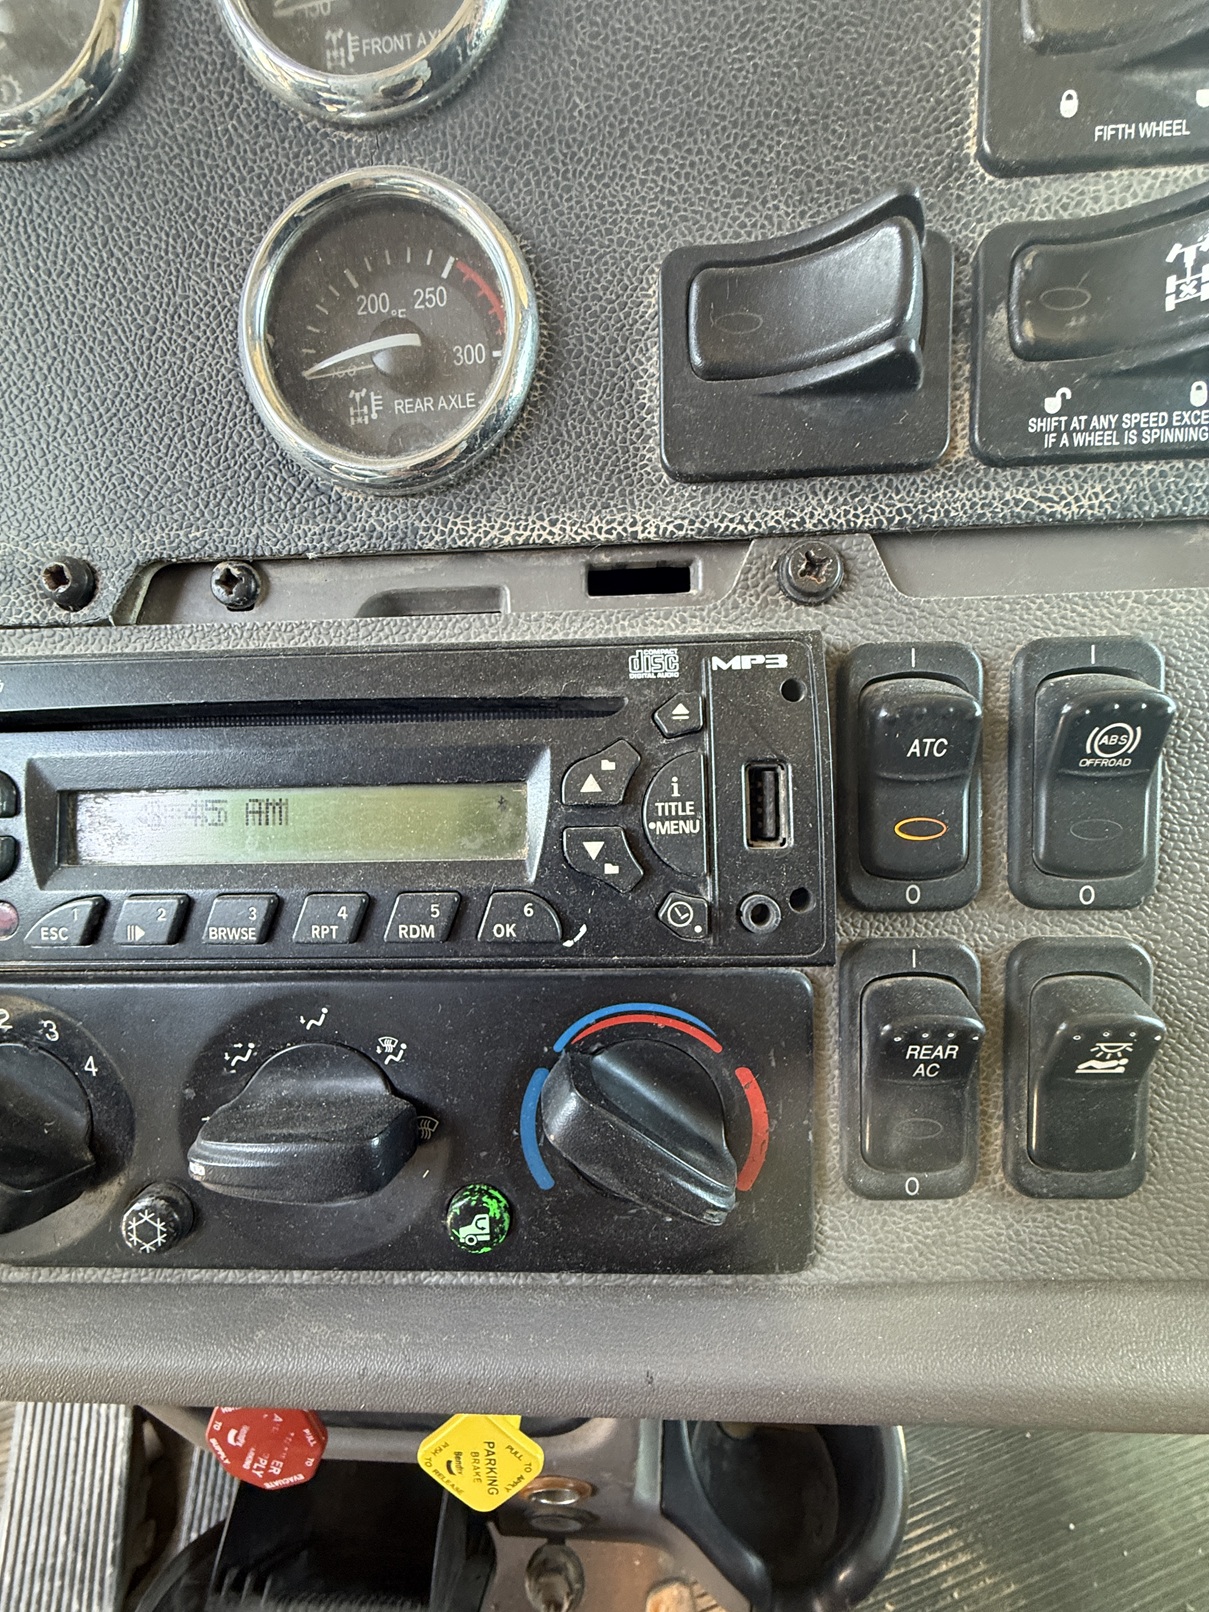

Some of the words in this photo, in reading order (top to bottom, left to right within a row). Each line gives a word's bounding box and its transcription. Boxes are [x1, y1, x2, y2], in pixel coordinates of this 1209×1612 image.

[362, 33, 412, 56] FRONT
[1094, 123, 1136, 142] FIFTH
[1138, 119, 1191, 138] WHEEL
[357, 293, 390, 315] 200
[413, 286, 448, 309] 250
[453, 343, 486, 366] 300
[394, 399, 434, 415] REAR
[437, 392, 476, 411] AXLE
[1028, 416, 1068, 433] SHIFT
[1070, 415, 1088, 431] AT
[1089, 414, 1119, 430] ANY
[1121, 411, 1168, 429] SPEED
[1044, 433, 1057, 448] IF
[1059, 433, 1070, 447] A
[1072, 430, 1121, 447] WHEEL
[1124, 430, 1139, 445] IS
[1141, 425, 1209, 444] SPINNING
[711, 654, 788, 671] MP3
[906, 738, 948, 758] ATC
[1098, 734, 1128, 746] ABS
[1078, 758, 1132, 768] OFFROAD
[246, 798, 288, 826] AM
[655, 801, 695, 816] TITLE
[72, 908, 79, 922] 1
[157, 908, 167, 922] 2
[248, 906, 257, 921] 3
[337, 906, 348, 920] 4
[430, 904, 440, 918] 5
[523, 902, 534, 917] 6
[40, 926, 69, 941] ESC
[208, 926, 257, 941] BRWSE
[311, 925, 338, 939] RPT
[398, 924, 435, 939] RDM
[493, 923, 517, 938] OK
[43, 1019, 60, 1042] 3
[905, 1044, 959, 1061] REAR
[84, 1055, 99, 1077] 4
[912, 1063, 941, 1078] AC
[505, 1444, 524, 1462] PULL
[304, 1457, 315, 1467] TO
[470, 1451, 483, 1484] BRAKE
[483, 1441, 500, 1496] PARKING
[523, 1461, 533, 1473] TO
[424, 1457, 433, 1468] TO
[432, 1468, 465, 1496] RELEASE
[504, 1474, 525, 1493] APPLY
